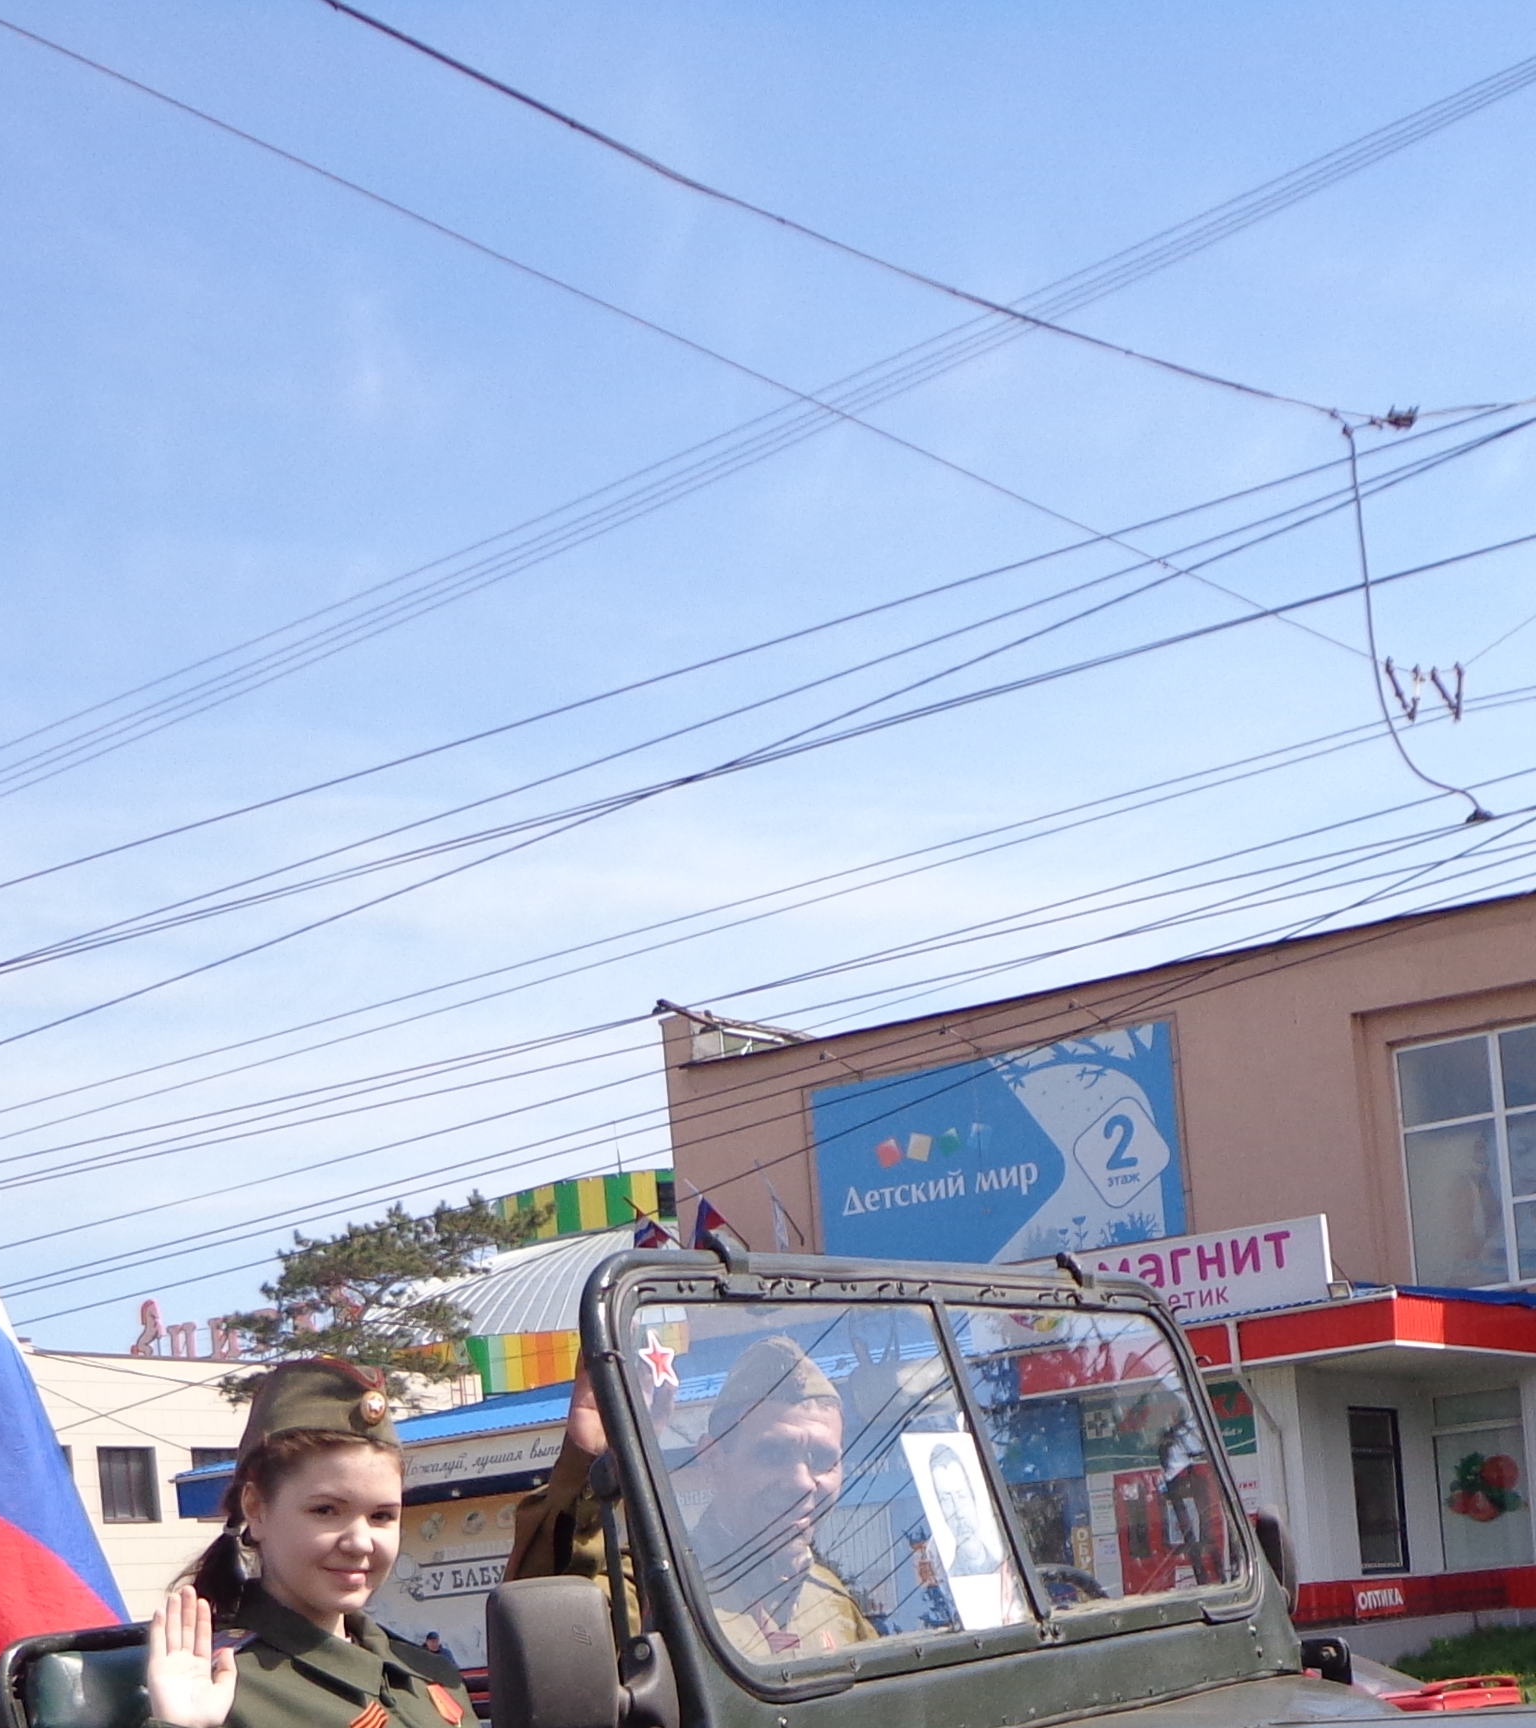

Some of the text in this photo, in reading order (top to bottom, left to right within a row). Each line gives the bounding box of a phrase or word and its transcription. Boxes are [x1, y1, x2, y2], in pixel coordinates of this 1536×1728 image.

[1103, 1113, 1139, 1171] 2
[842, 1162, 1039, 1217] Детский мир
[472, 1450, 523, 1474] лучшая
[1357, 1587, 1404, 1610] ОПТИКА
